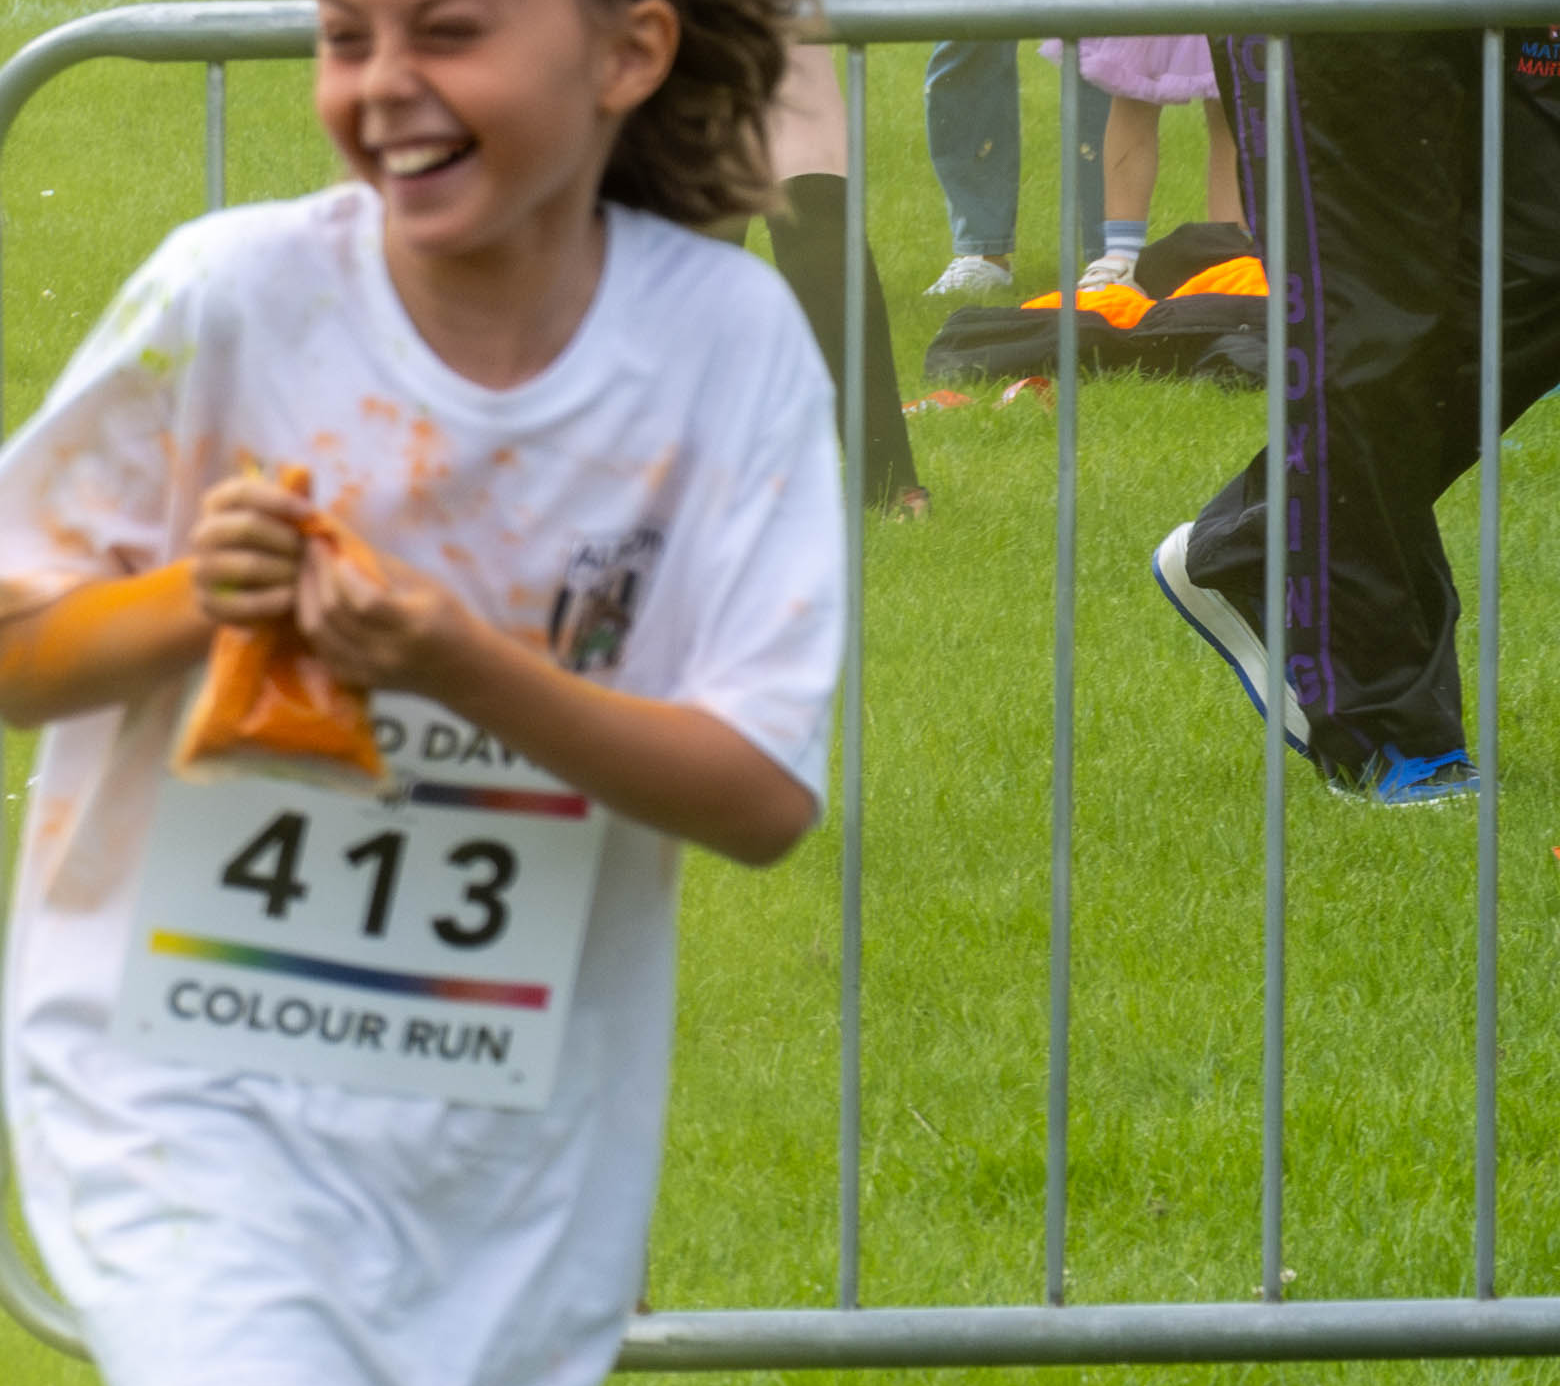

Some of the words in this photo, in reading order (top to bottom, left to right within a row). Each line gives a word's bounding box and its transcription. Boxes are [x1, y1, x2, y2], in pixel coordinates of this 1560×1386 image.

[220, 810, 519, 951] 413
[167, 979, 386, 1051] COLOUR
[403, 1018, 515, 1065] RUN
